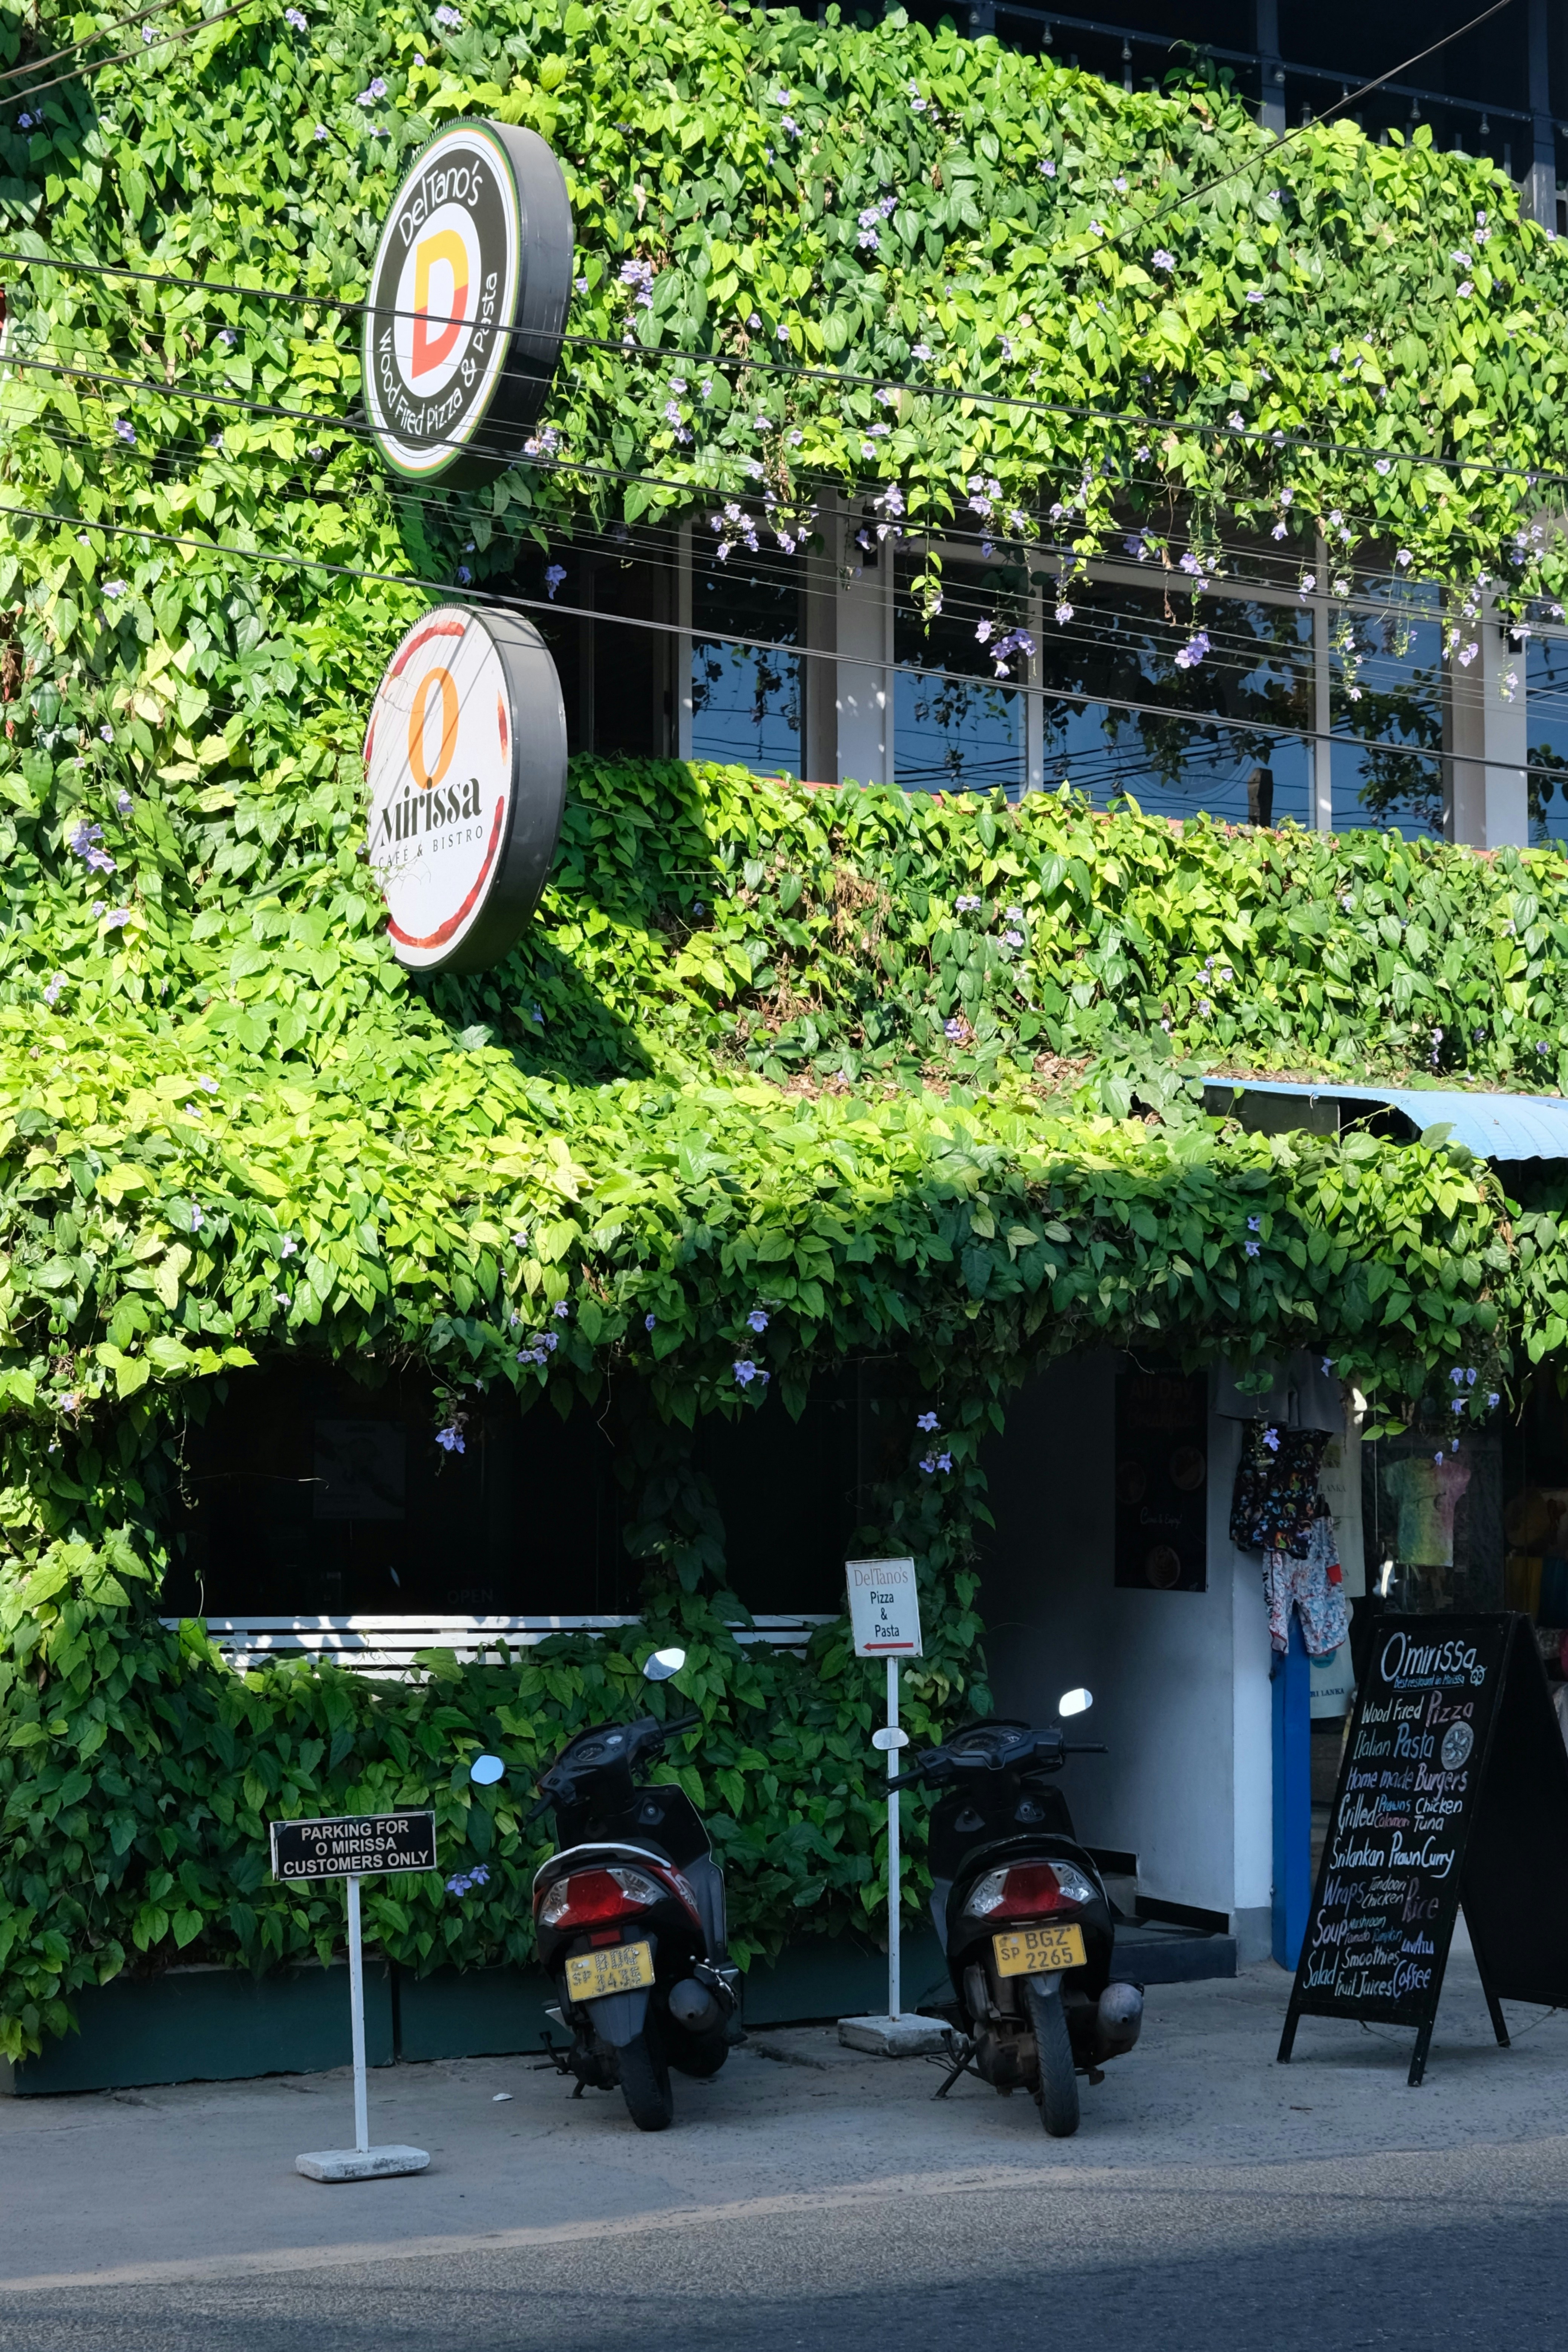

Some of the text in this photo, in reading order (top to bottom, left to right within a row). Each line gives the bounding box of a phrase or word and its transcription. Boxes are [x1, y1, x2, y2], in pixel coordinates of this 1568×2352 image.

[399, 160, 483, 247] DelTano's
[379, 272, 497, 435] Wood Fired Pizza & Pasta
[380, 777, 482, 847] Mirissa
[379, 825, 482, 868] CAFÉ & BISTRO
[1319, 1484, 1347, 1492] LANKA
[854, 1567, 908, 1586] DelTano's
[870, 1591, 894, 1604] Pizza
[881, 1607, 888, 1620] &
[875, 1625, 900, 1637] Pasta
[1321, 1687, 1344, 1696] LANKA
[1361, 1690, 1474, 1727] Wood Fired Pizza
[1353, 1722, 1435, 1760] Italian Pasta
[1346, 1762, 1468, 1801] Home made Burgers
[1338, 1793, 1462, 1836] Grilled Prawns Chicken
[1414, 1815, 1444, 1833] Tuna
[302, 1820, 409, 1841] PARKING FOR
[315, 1837, 397, 1856] O MIRISSA
[1389, 1830, 1420, 1868] Prawn
[1421, 1836, 1455, 1878] Curry
[284, 1850, 429, 1875] CUSTOMERS ONLY
[1323, 1874, 1367, 1917] Wraps
[1401, 1877, 1439, 1923] Rice
[1361, 1892, 1403, 1908] Chicken
[1025, 1928, 1068, 1949] BGZ
[1312, 1908, 1348, 1948] Soup
[1001, 1947, 1073, 1970] SP 2265
[1303, 1944, 1401, 1989] Salad Smoothies
[573, 1970, 591, 1986] SP
[1335, 1960, 1431, 1998] Fruit Juices Coffee
